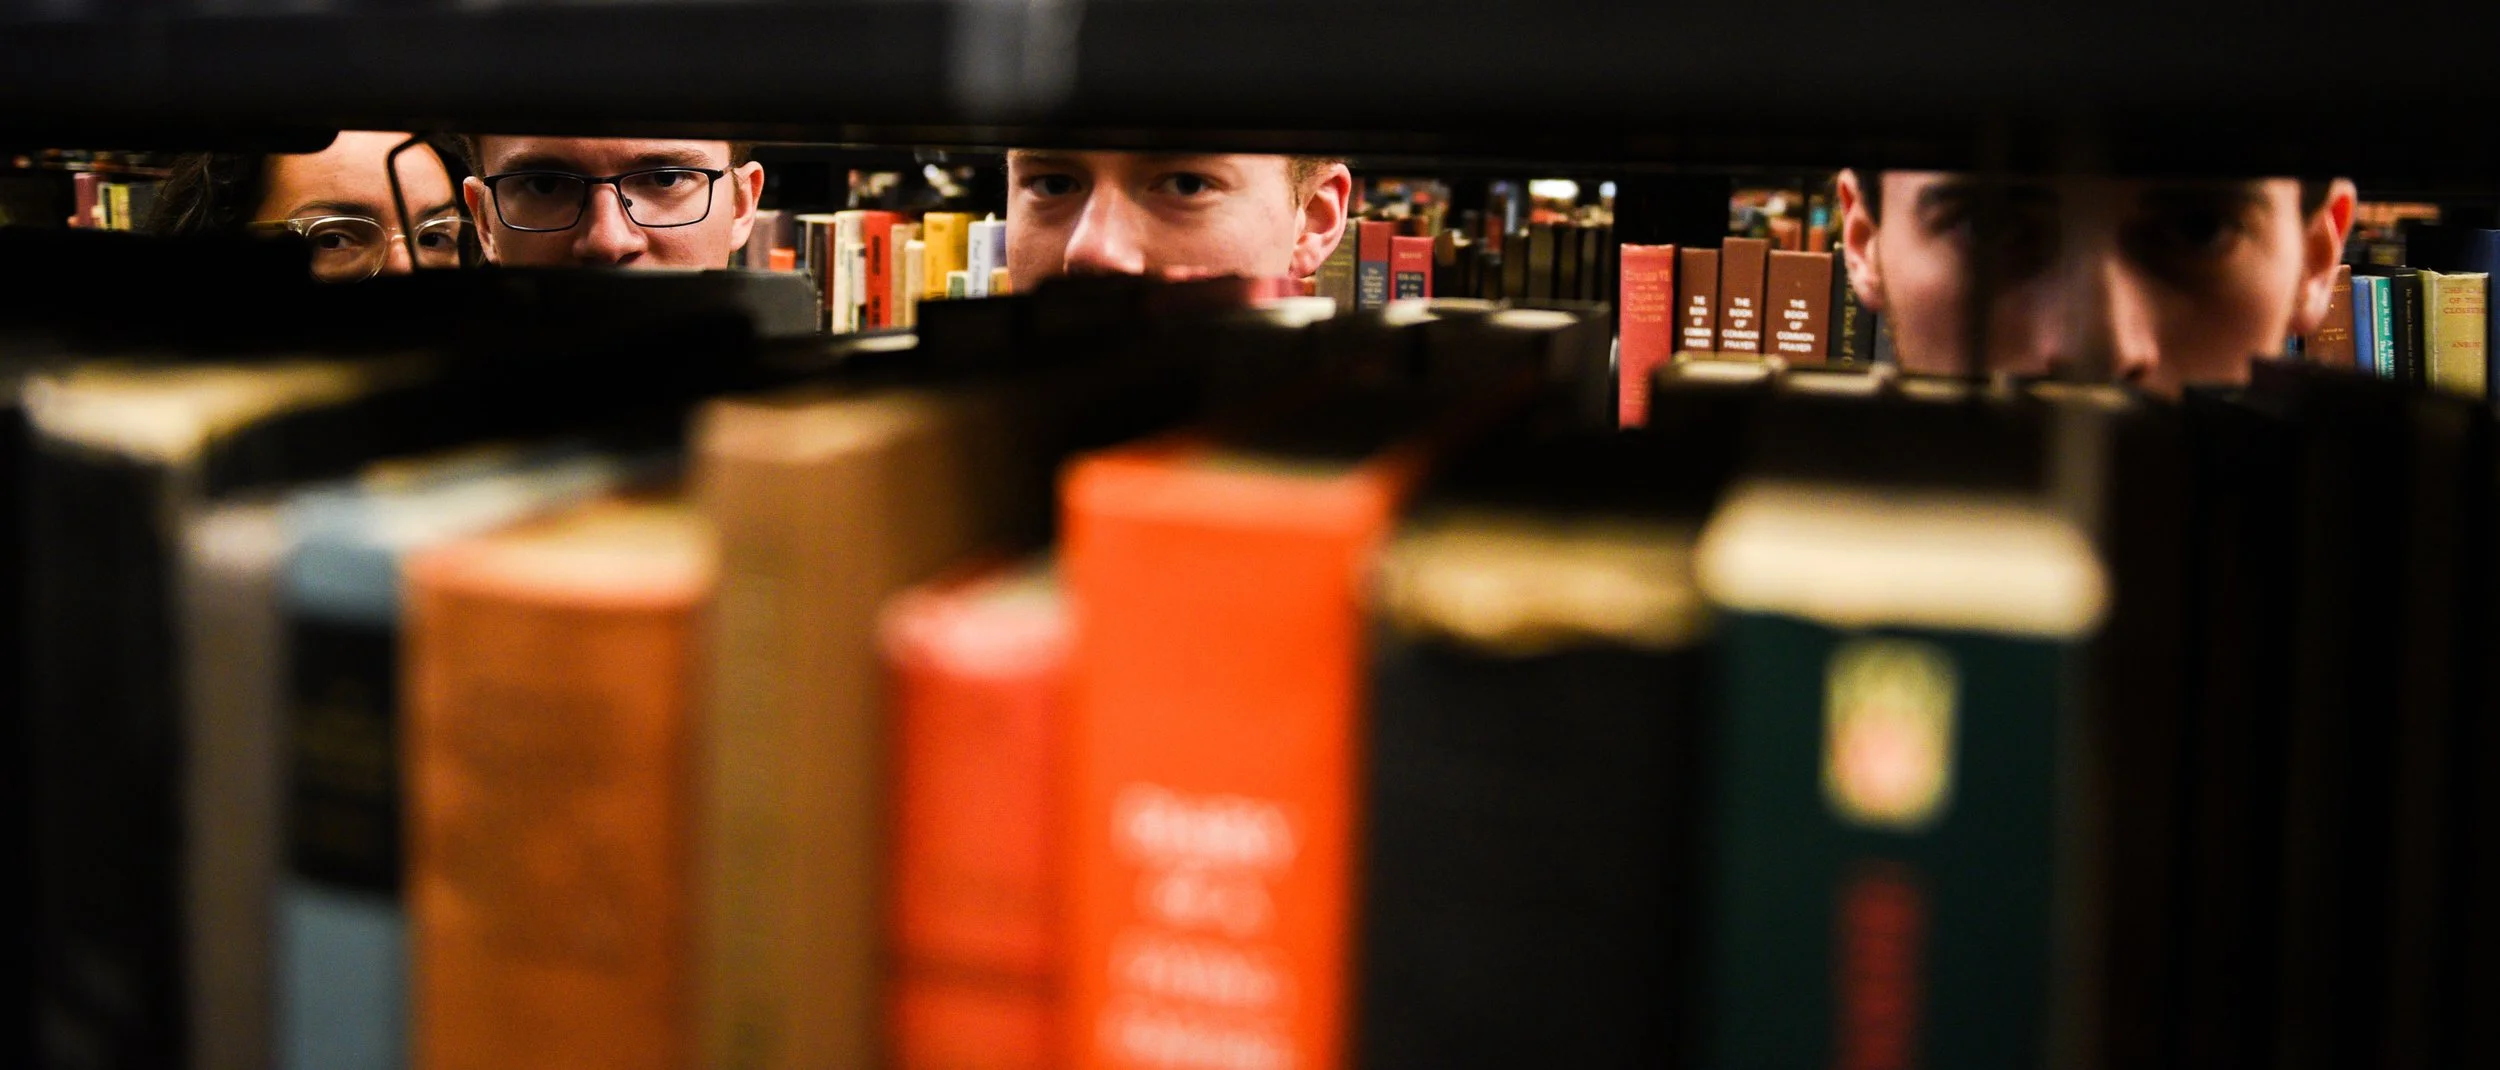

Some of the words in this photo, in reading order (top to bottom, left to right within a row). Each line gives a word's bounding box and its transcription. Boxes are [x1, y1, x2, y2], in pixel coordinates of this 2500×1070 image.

[1734, 297, 1751, 307] THE
[2382, 287, 2390, 307] George
[1790, 299, 1806, 309] THE
[1729, 308, 1753, 318] BOOK
[1784, 310, 1809, 320] BOOK
[1734, 319, 1747, 329] OF
[1789, 321, 1803, 330] OF
[1722, 329, 1759, 339] COMMON
[1776, 331, 1815, 342] COMMON
[1723, 340, 1757, 350] PRAYER
[1778, 342, 1812, 352] PRAYER
[2379, 340, 2387, 351] The
